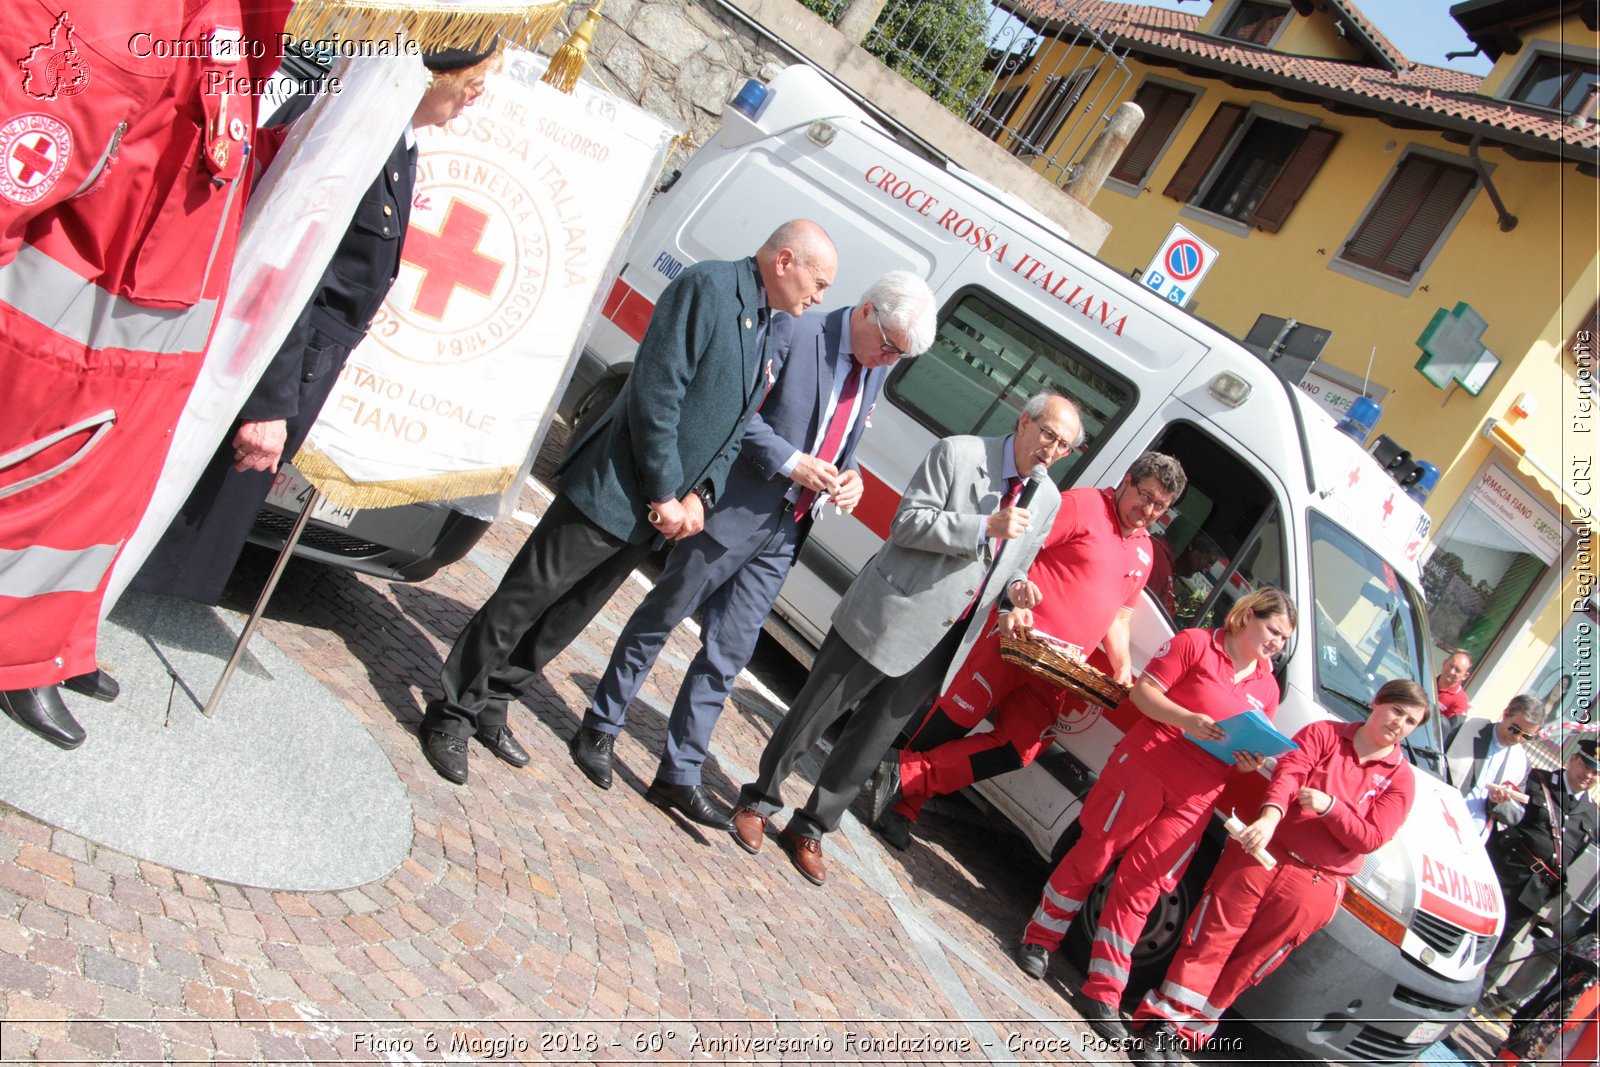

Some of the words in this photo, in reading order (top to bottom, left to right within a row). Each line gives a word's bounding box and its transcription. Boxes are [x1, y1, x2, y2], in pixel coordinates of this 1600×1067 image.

[448, 159, 532, 224] GINEVRA
[523, 233, 544, 258] 22
[532, 154, 587, 288] ITALIANA
[652, 250, 687, 280] FOND
[865, 165, 939, 217] CROCE
[936, 208, 1009, 264] ROSSA
[1012, 253, 1128, 337] ITALIANA
[488, 266, 542, 338] AGOSTO
[336, 394, 428, 444] FIANO
[408, 388, 497, 434] LOCALE
[1510, 497, 1533, 519] FIANO
